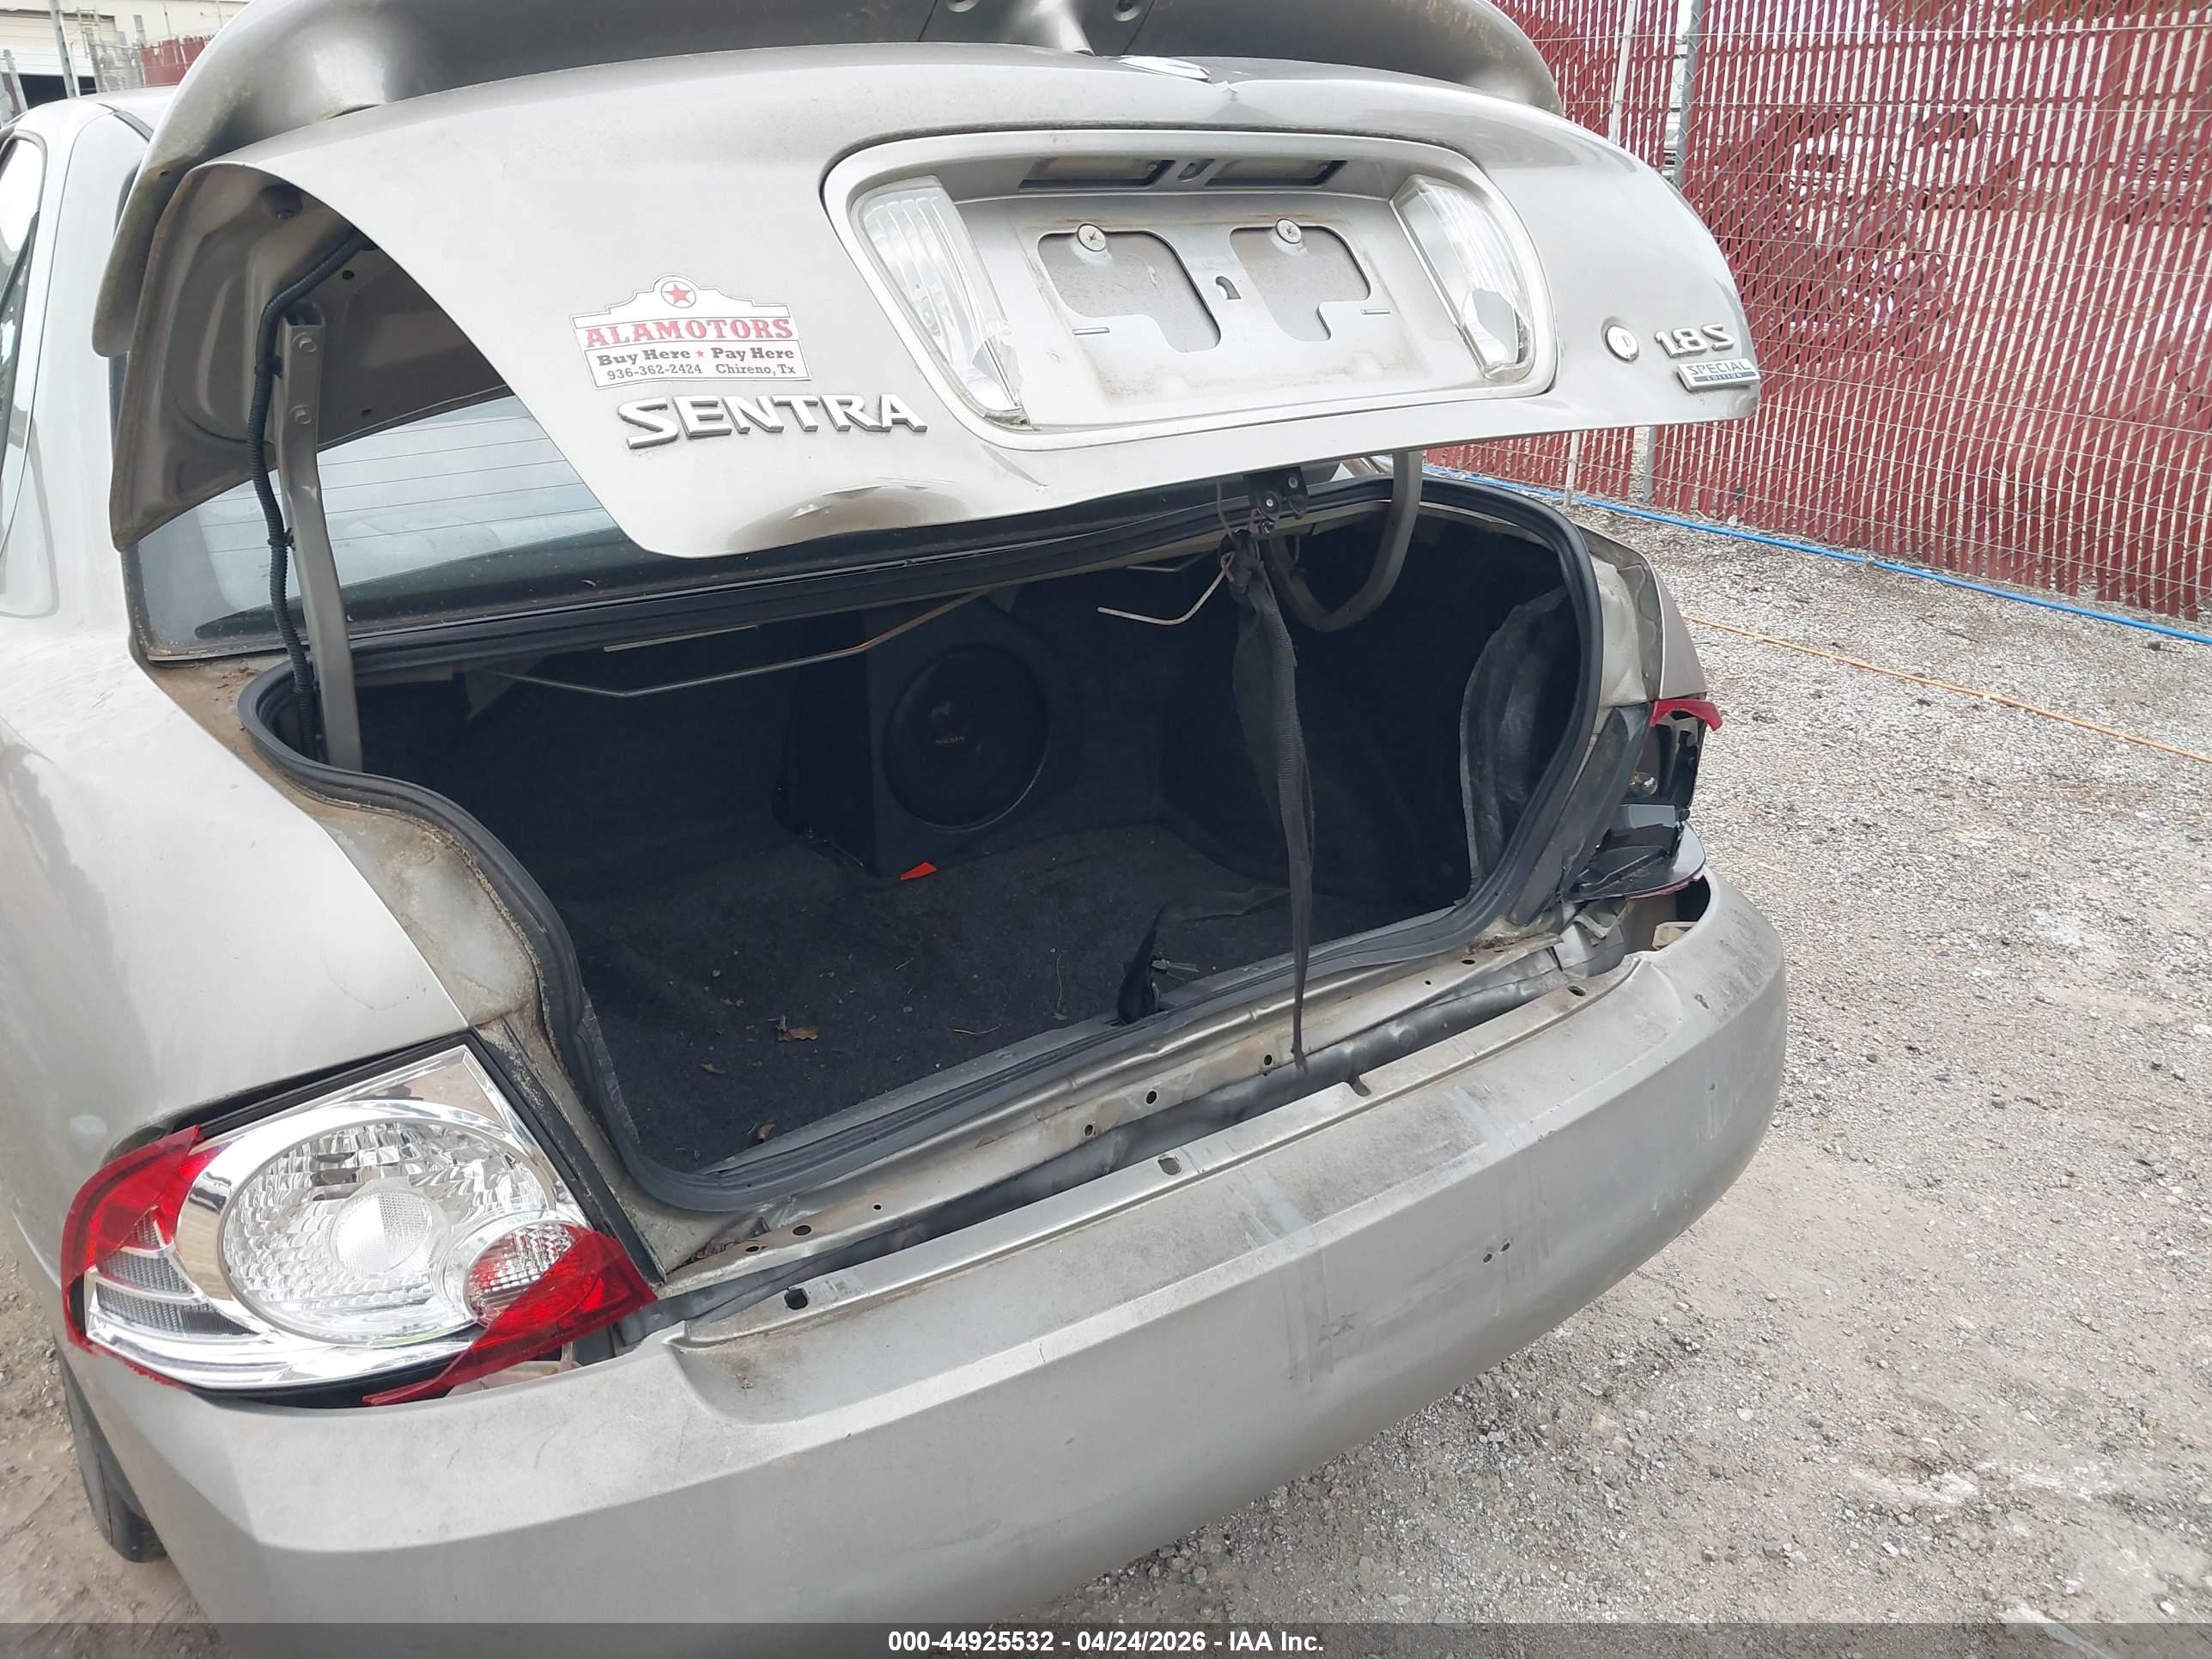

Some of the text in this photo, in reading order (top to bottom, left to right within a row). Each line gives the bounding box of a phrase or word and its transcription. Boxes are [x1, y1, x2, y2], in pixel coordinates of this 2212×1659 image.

[586, 319, 793, 348] ALAMOTORS
[597, 347, 794, 367] Buy Here Pay Here
[607, 363, 796, 380] 936-362-2424 Chireno, Tx
[1686, 361, 1752, 376] SPECIAL
[618, 393, 927, 449] SENTRA
